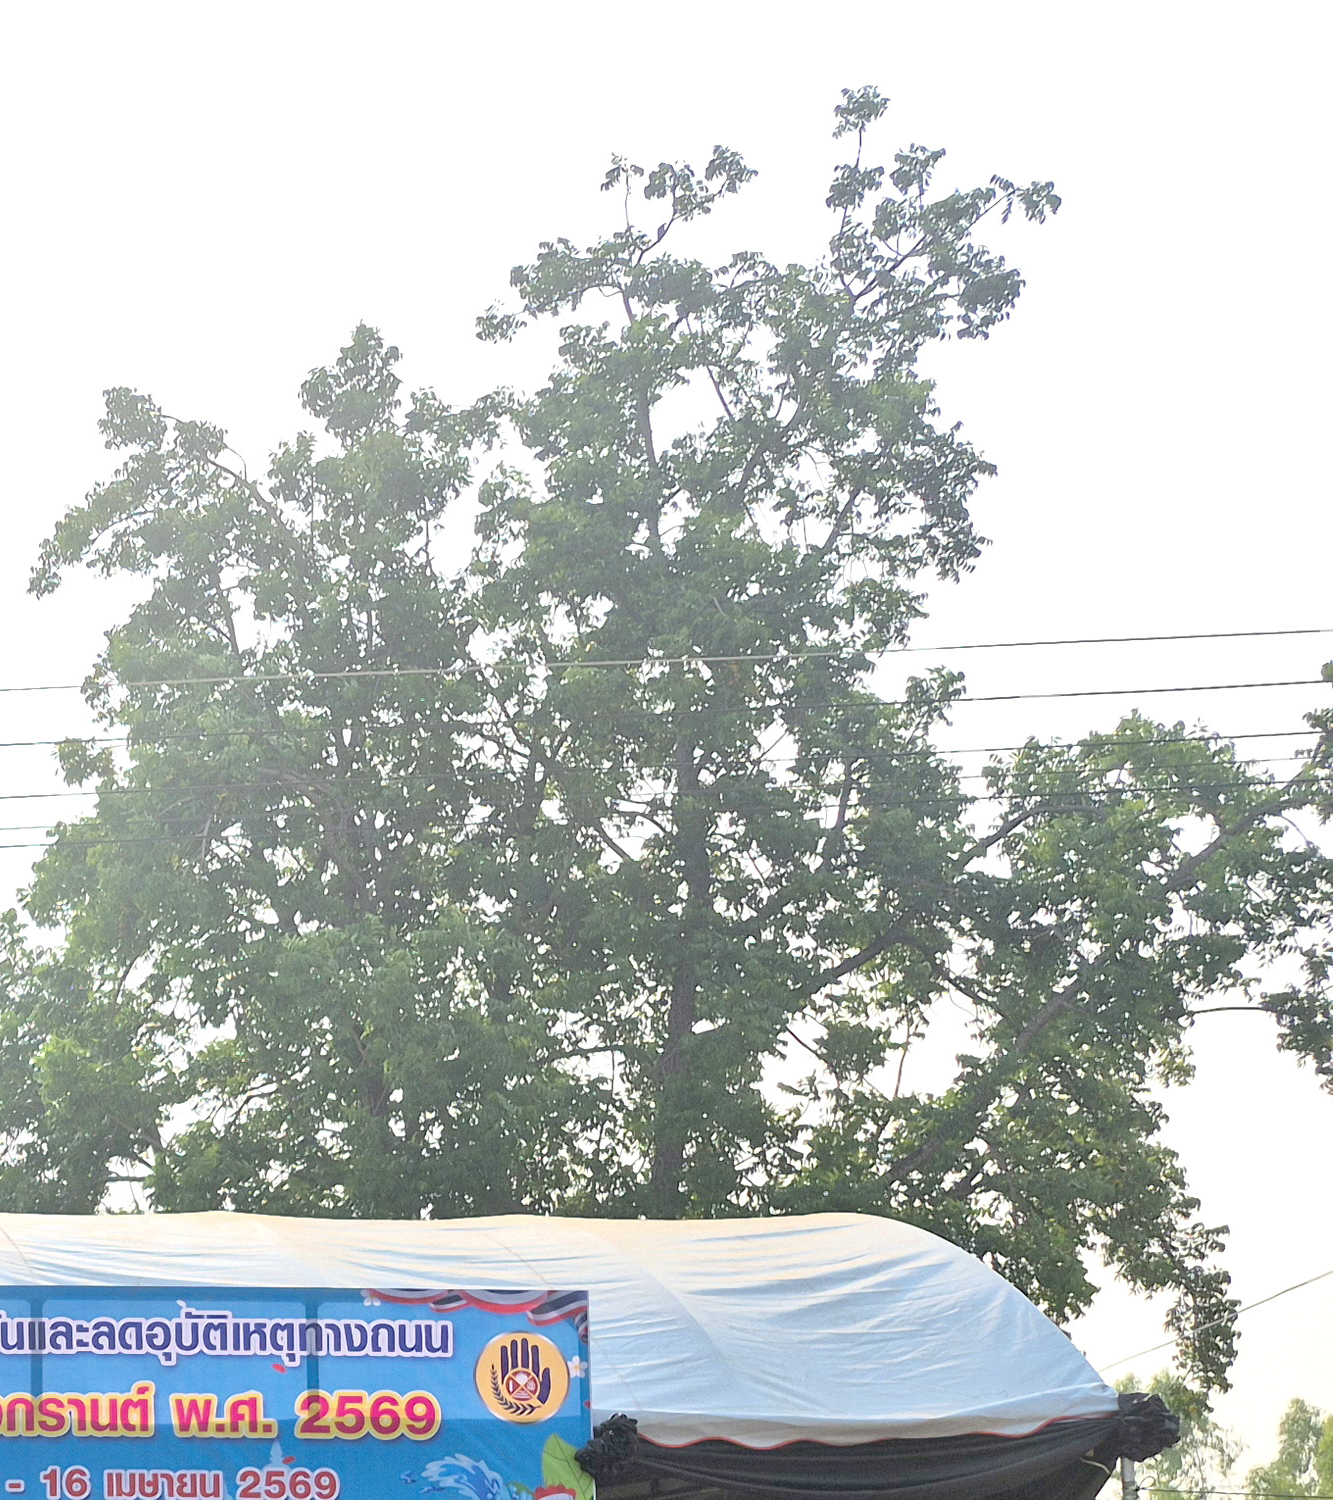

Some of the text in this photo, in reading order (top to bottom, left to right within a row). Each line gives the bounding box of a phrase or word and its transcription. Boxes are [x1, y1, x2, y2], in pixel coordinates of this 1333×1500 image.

[175, 1396, 272, 1432] พ.ศ.
[299, 1394, 437, 1434] 2569
[43, 1469, 88, 1498] 16
[108, 1471, 221, 1498] เมษายน
[239, 1469, 338, 1499] 2569
